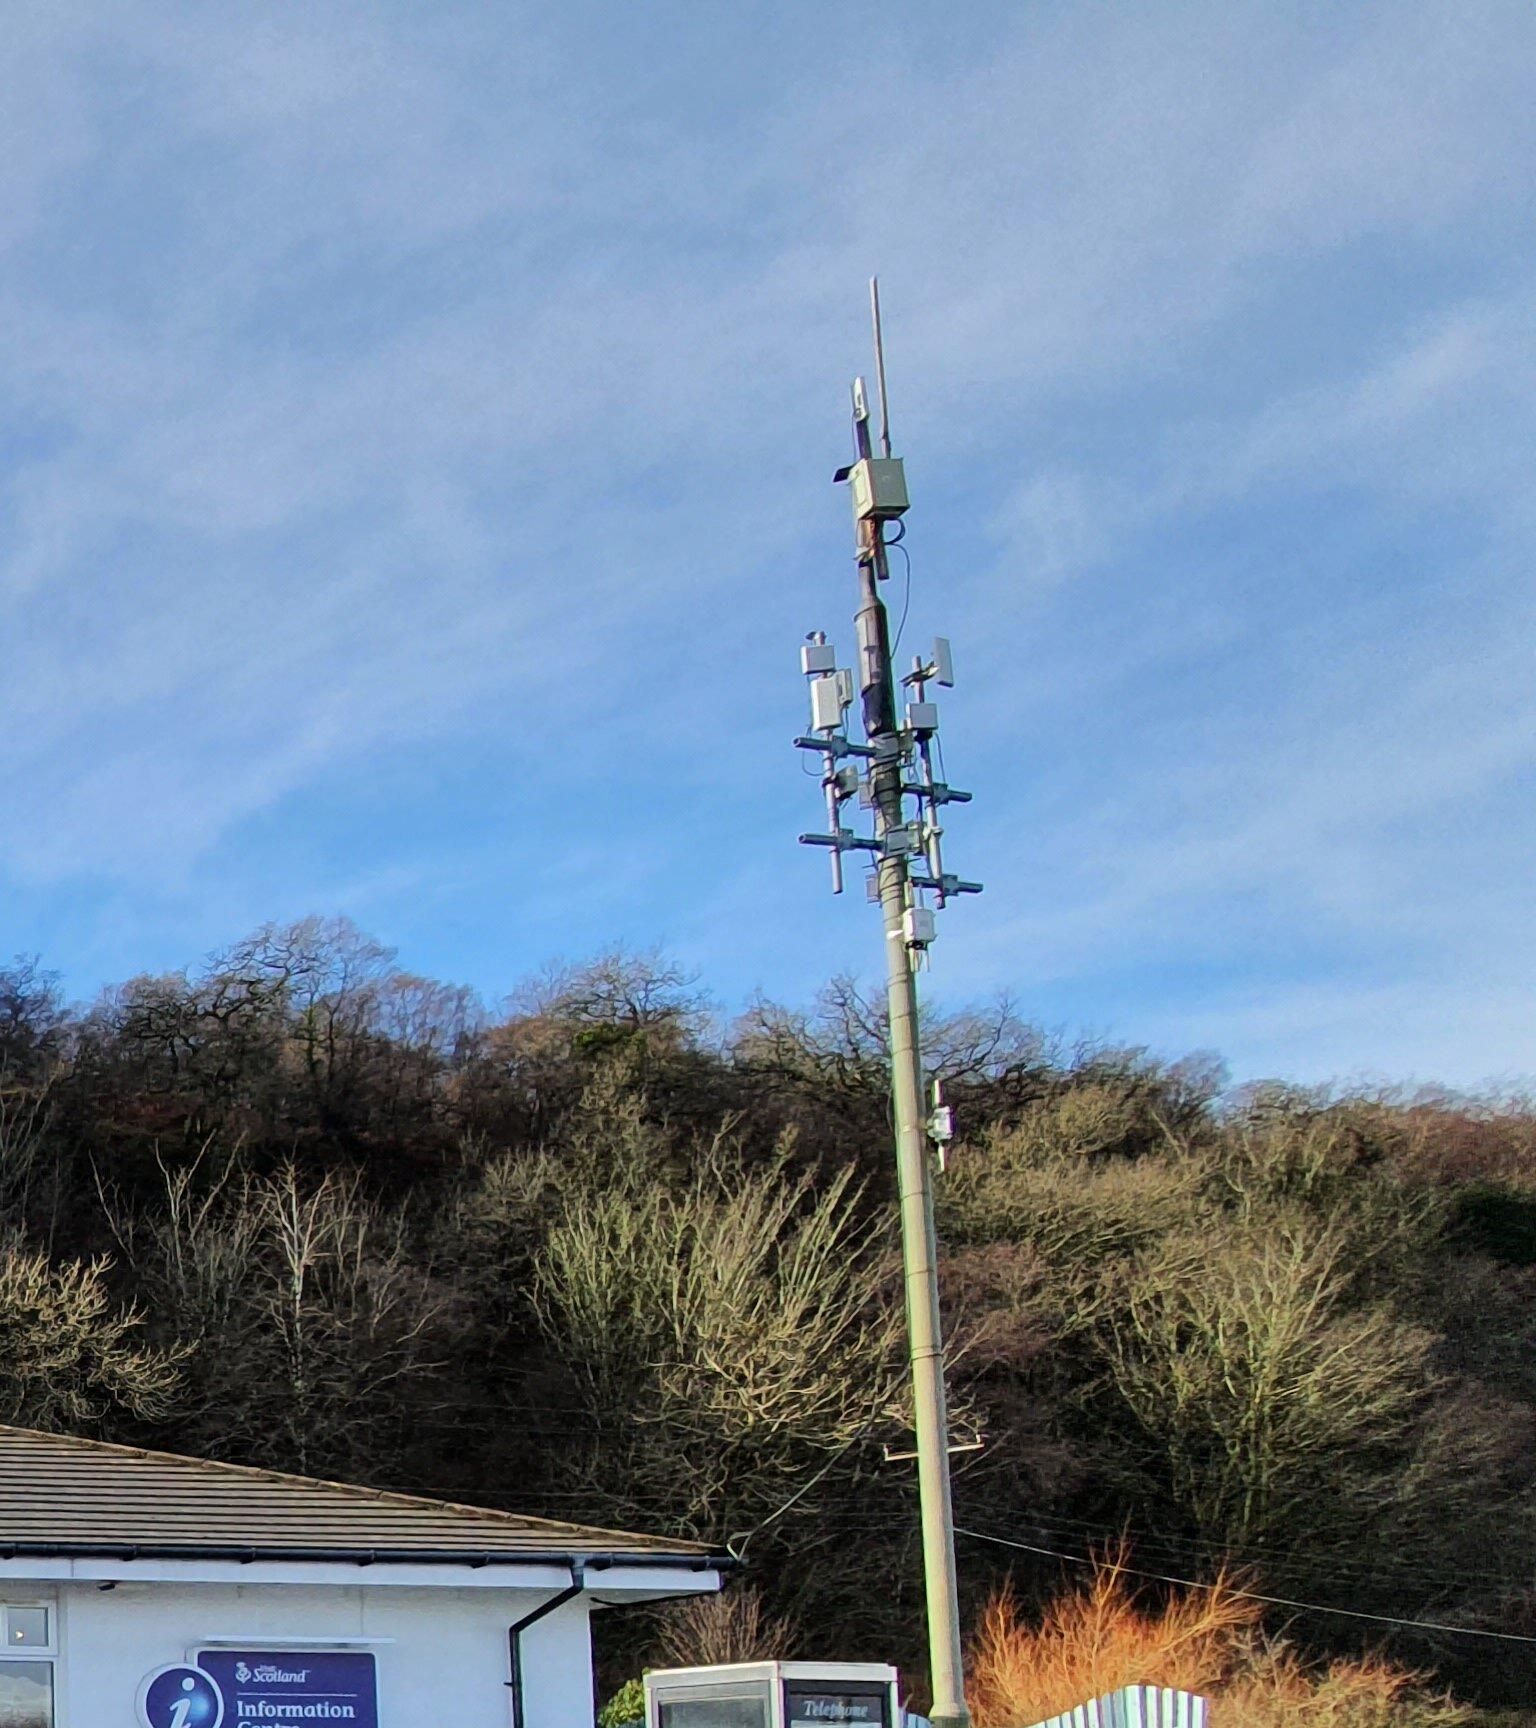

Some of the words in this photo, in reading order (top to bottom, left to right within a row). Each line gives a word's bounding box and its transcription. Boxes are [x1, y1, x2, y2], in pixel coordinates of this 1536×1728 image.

[253, 1667, 306, 1683] Scotland
[237, 1700, 356, 1719] Information
[803, 1700, 869, 1719] Telephone
